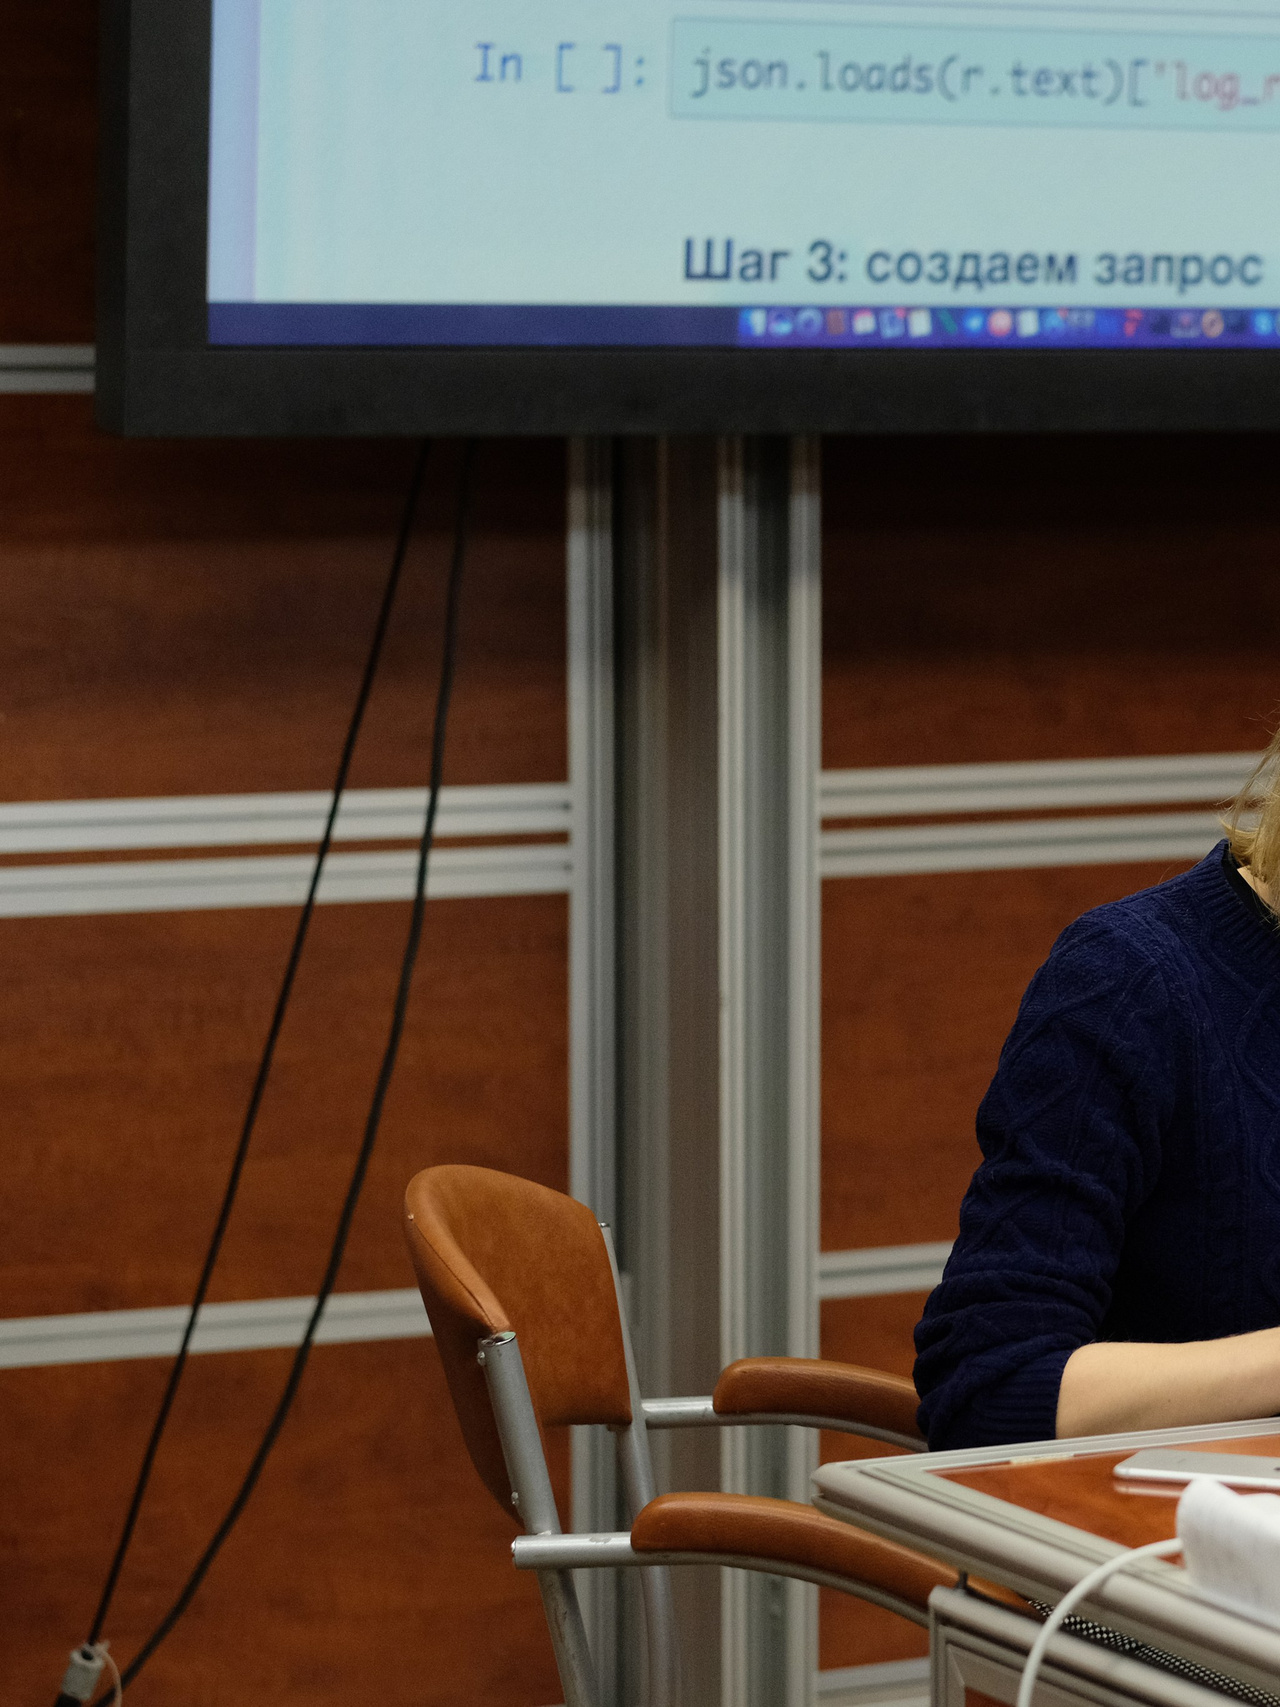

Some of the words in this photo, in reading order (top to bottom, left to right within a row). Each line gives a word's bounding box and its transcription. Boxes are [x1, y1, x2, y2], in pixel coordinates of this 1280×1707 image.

[474, 42, 522, 84] In
[683, 238, 789, 281] Шаг
[807, 241, 848, 282] 3:
[865, 249, 1078, 290] создаем
[1093, 253, 1263, 294] запрос
